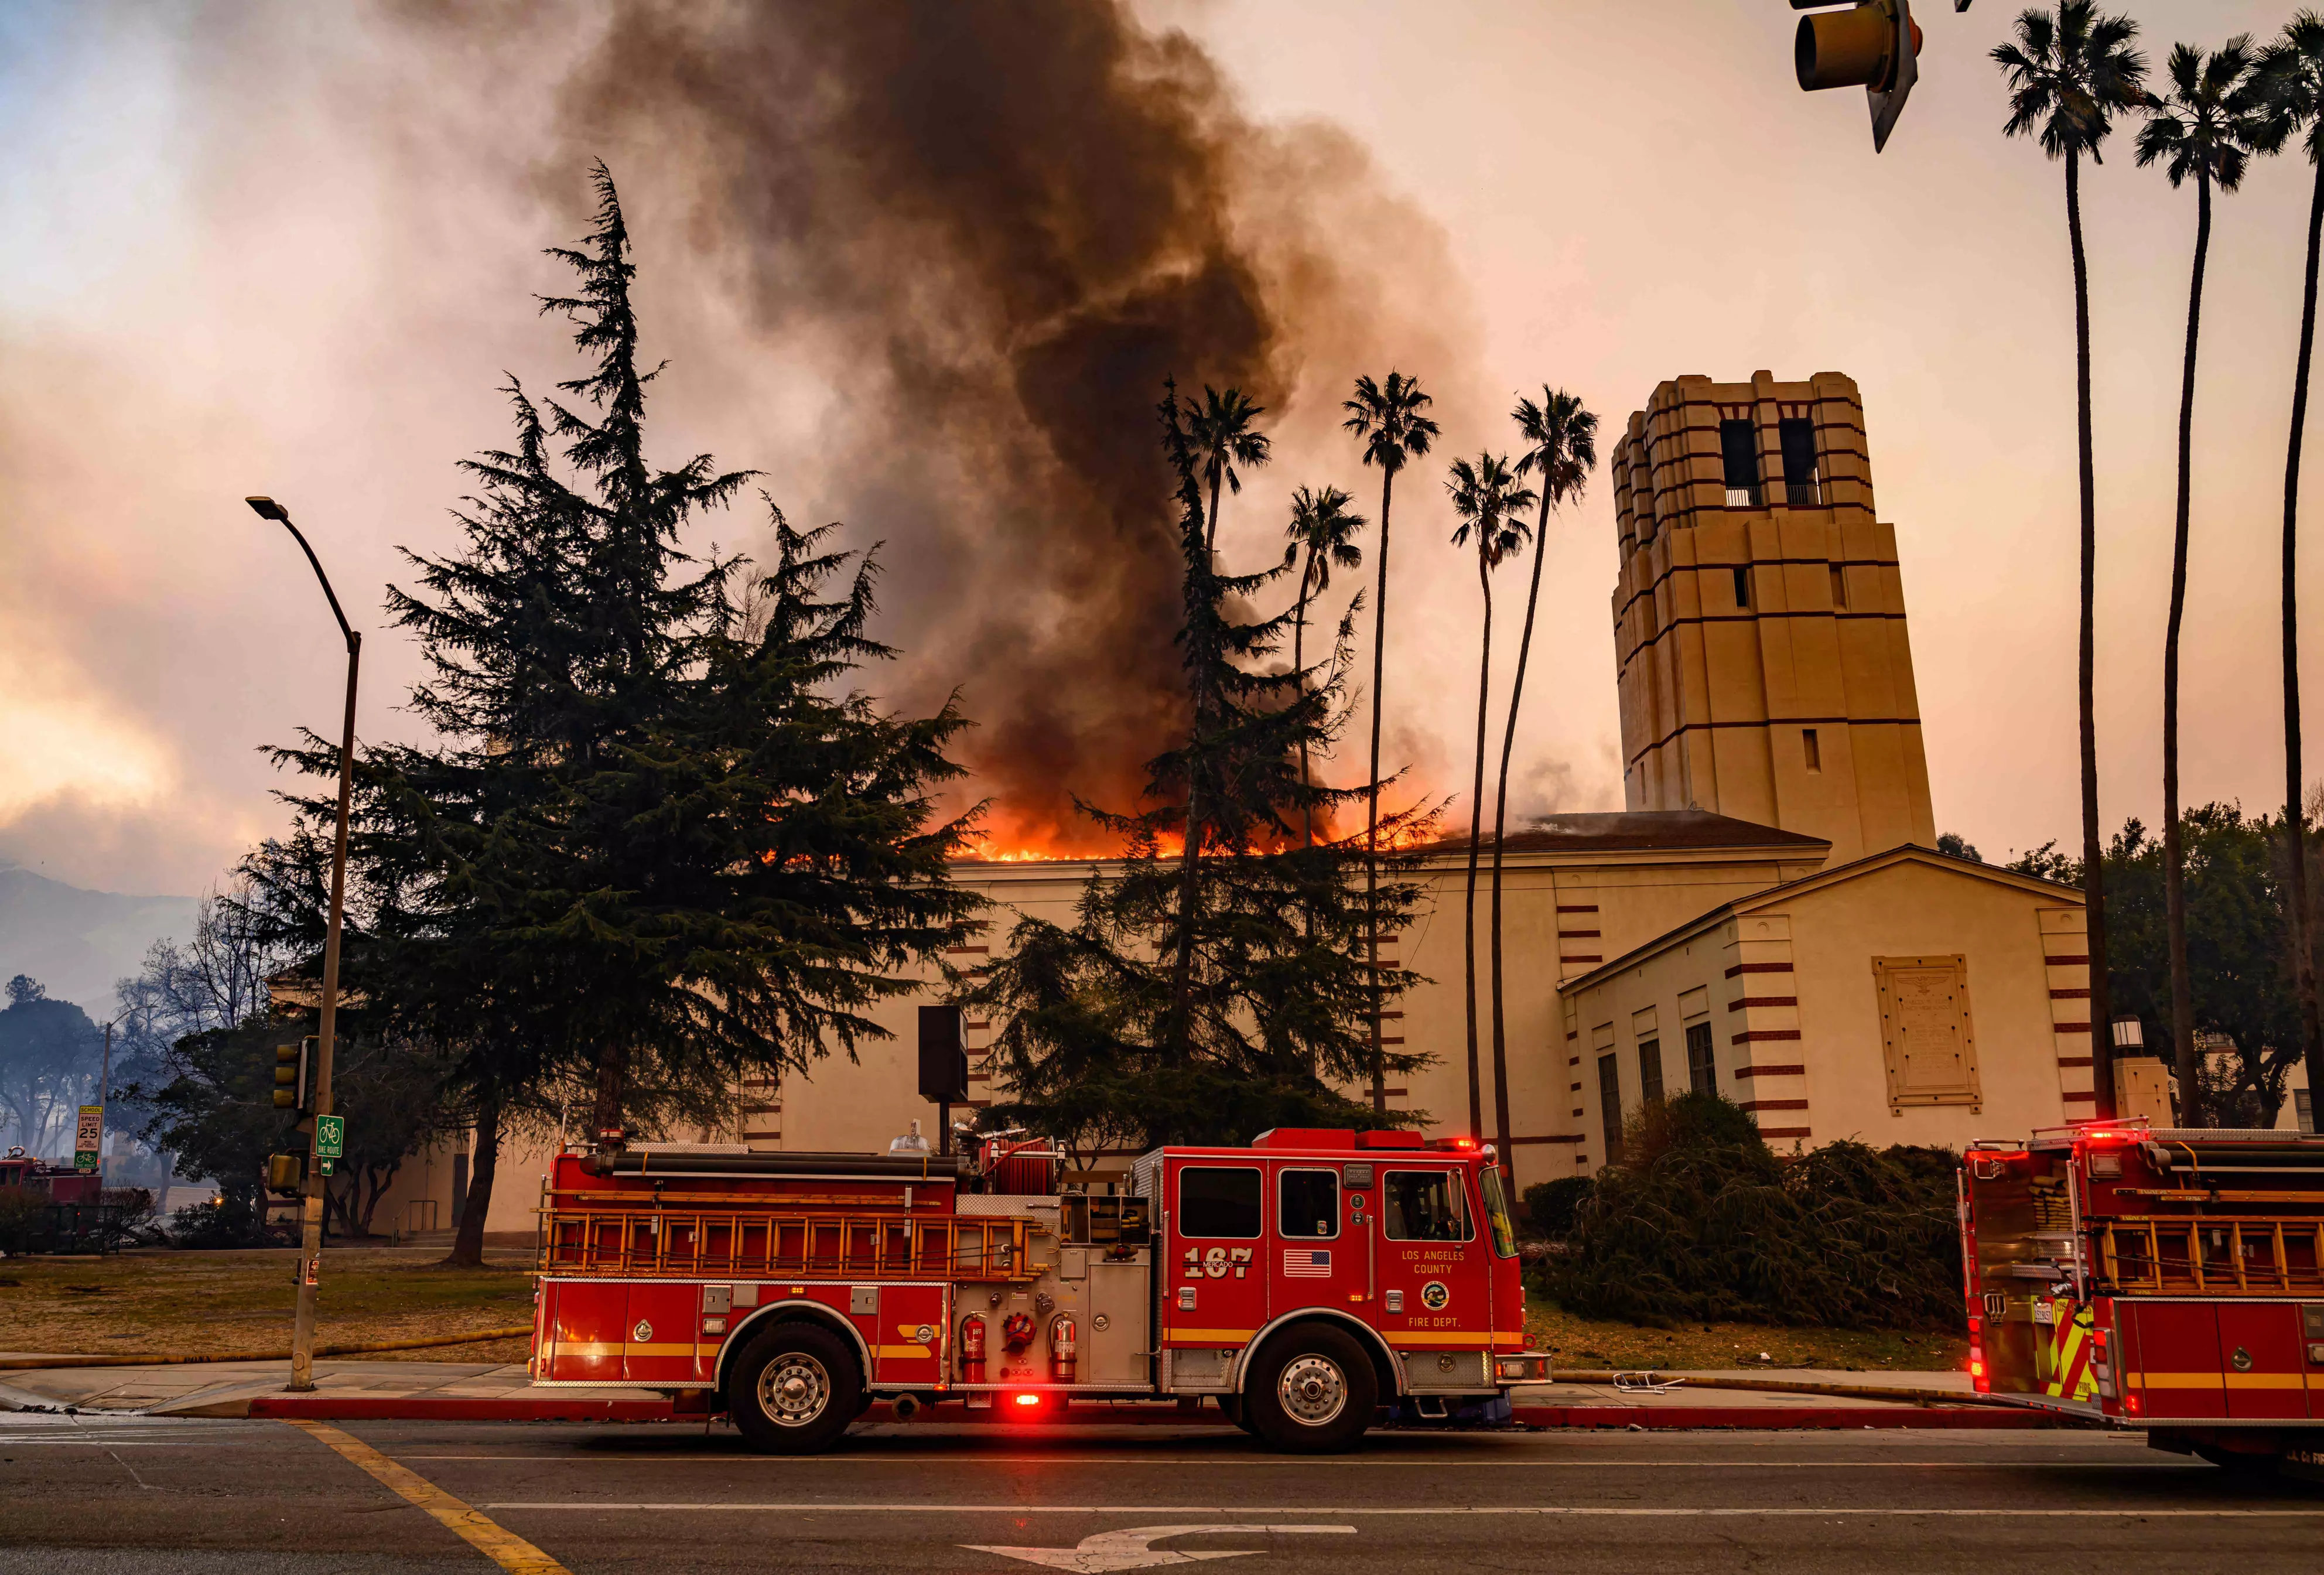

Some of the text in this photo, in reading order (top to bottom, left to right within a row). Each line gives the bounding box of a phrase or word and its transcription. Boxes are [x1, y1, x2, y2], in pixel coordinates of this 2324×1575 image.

[79, 1128, 98, 1139] 25
[327, 1146, 340, 1154] ROUTE
[1402, 1251, 1464, 1260] LOS ANGELES
[1184, 1247, 1253, 1278] 167
[1414, 1264, 1452, 1274] COUNTY
[1409, 1317, 1461, 1327] FIRE DEPT.
